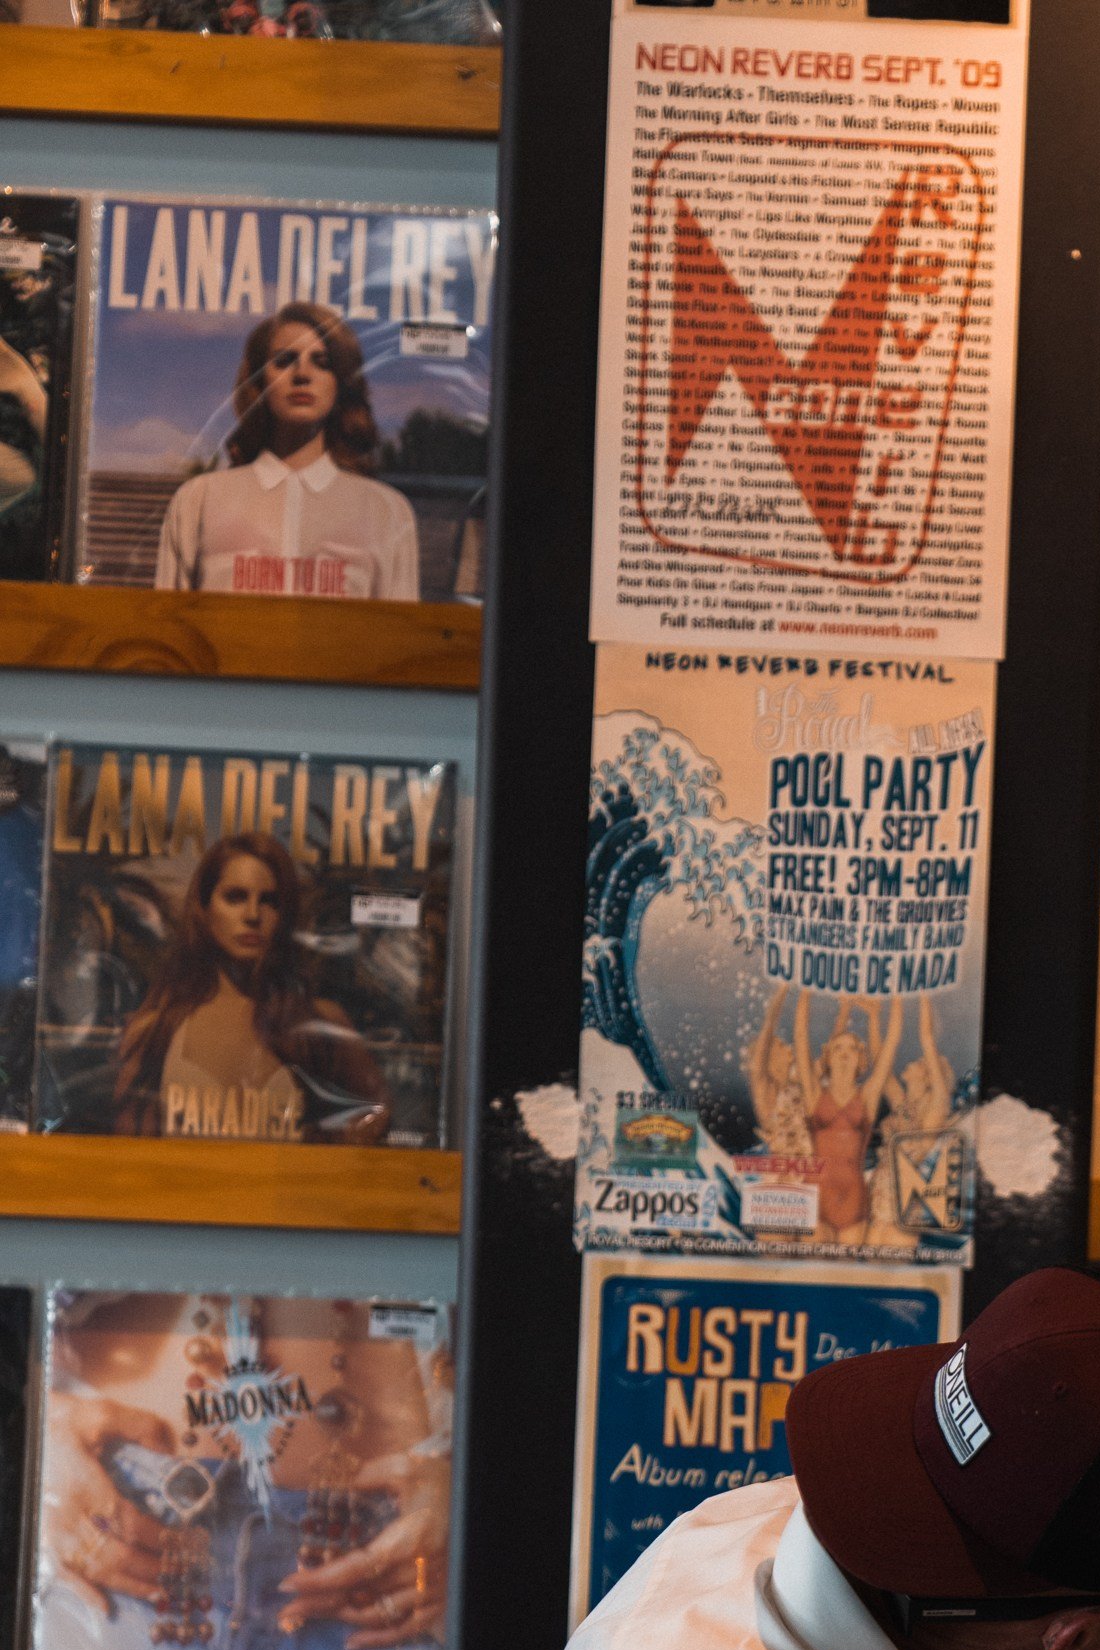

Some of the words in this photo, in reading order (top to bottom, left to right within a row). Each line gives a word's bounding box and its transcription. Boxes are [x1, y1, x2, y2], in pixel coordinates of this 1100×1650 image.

[635, 42, 724, 74] NEON
[731, 46, 854, 80] REVERB
[861, 54, 945, 87] SEPT.
[107, 205, 266, 315] LANA
[274, 213, 378, 323] DEL
[389, 219, 499, 327] REY
[660, 612, 687, 627] Full
[646, 652, 709, 671] NEON
[717, 653, 820, 677] REVERB
[828, 658, 956, 684] FESTIVAL
[769, 751, 852, 810] POOL
[862, 740, 987, 812] PARTY
[53, 748, 206, 856] LANA
[330, 763, 443, 873] REY
[768, 810, 875, 851] SUNDAY,
[881, 815, 949, 851] SEPT.
[959, 810, 980, 850] 11
[769, 853, 838, 895] FREE!
[846, 856, 973, 898] 3PM-8PM
[768, 942, 795, 981] DJ
[801, 949, 860, 993] DOUG
[866, 954, 893, 994] DE
[732, 1154, 827, 1175] WEEKLY
[595, 1178, 699, 1223] Zappos
[625, 1303, 809, 1383] RUSTY
[186, 1376, 314, 1428] MADONNA
[610, 1441, 707, 1489] Album
